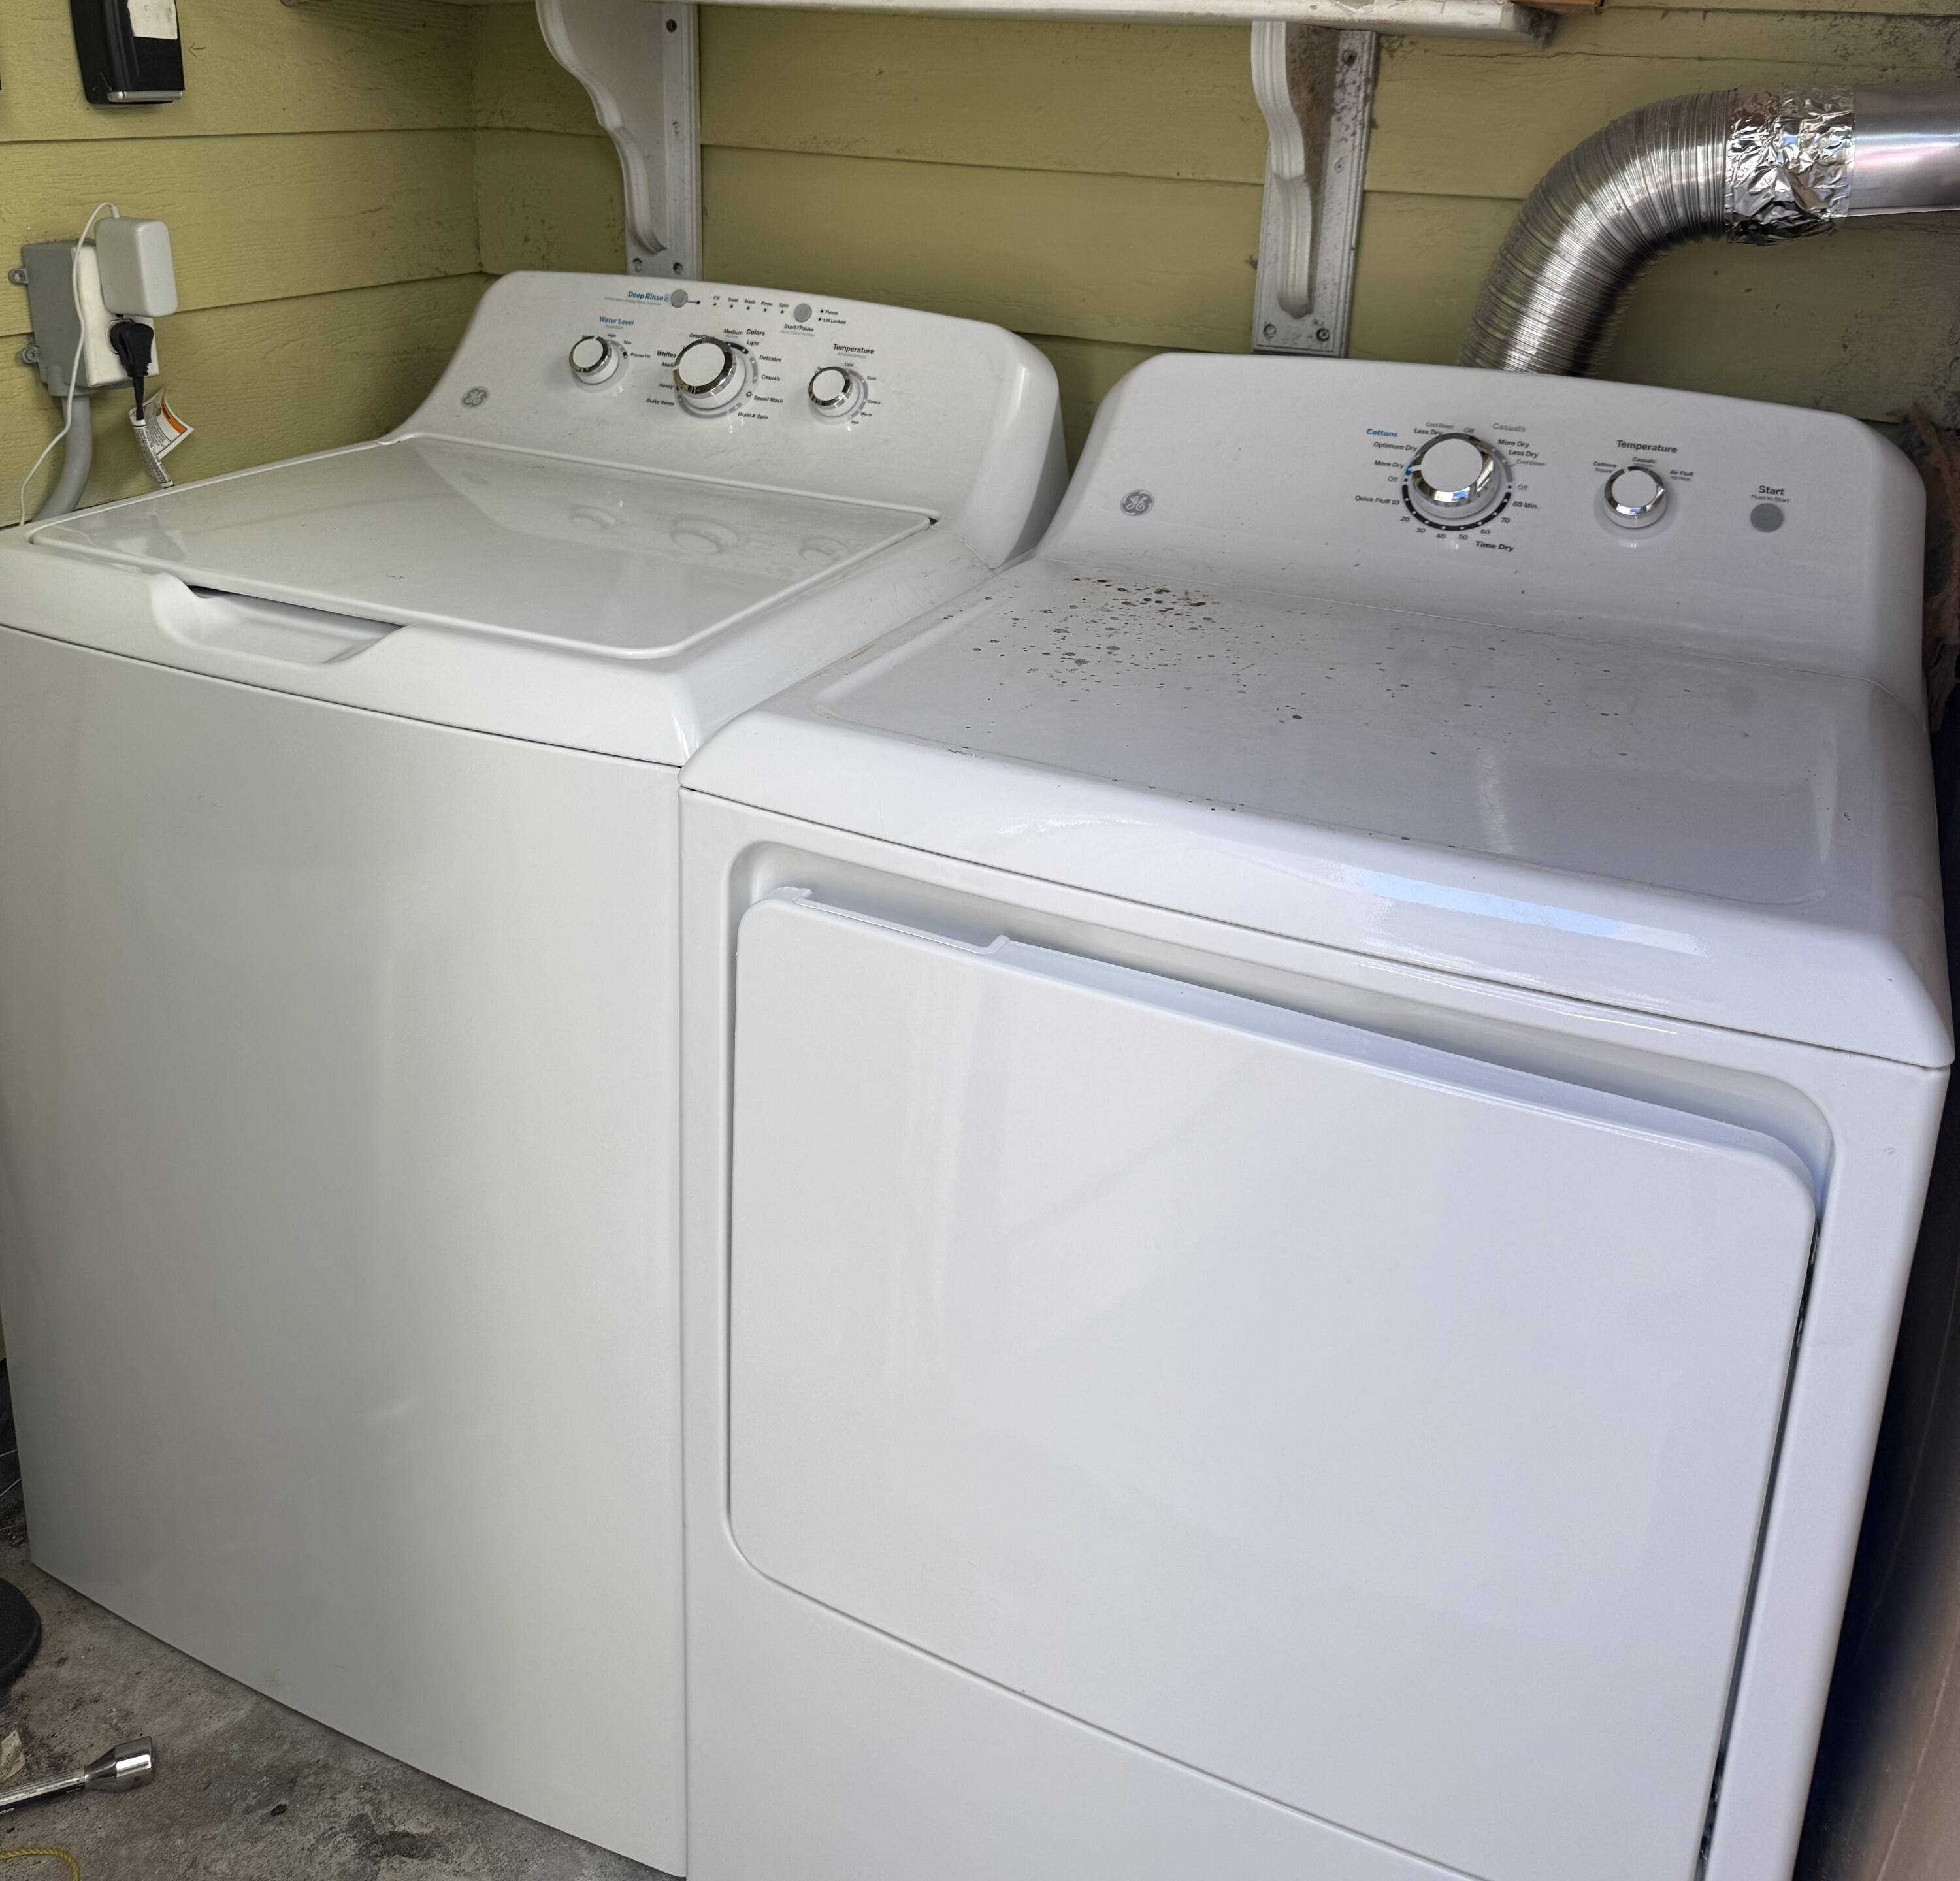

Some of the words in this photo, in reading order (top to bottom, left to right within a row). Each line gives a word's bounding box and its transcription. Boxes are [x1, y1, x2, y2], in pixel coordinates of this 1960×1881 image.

[628, 291, 644, 299] Deep
[784, 323, 814, 332] Start/Pause
[833, 344, 875, 355] Temperature
[1366, 428, 1398, 438] Cottons
[1492, 423, 1526, 433] Casuals
[1373, 441, 1404, 450] Optimum
[1617, 440, 1678, 453] Temperature
[1758, 485, 1785, 496] Start
[1475, 540, 1497, 549] Time
[1498, 544, 1514, 553] Dry
